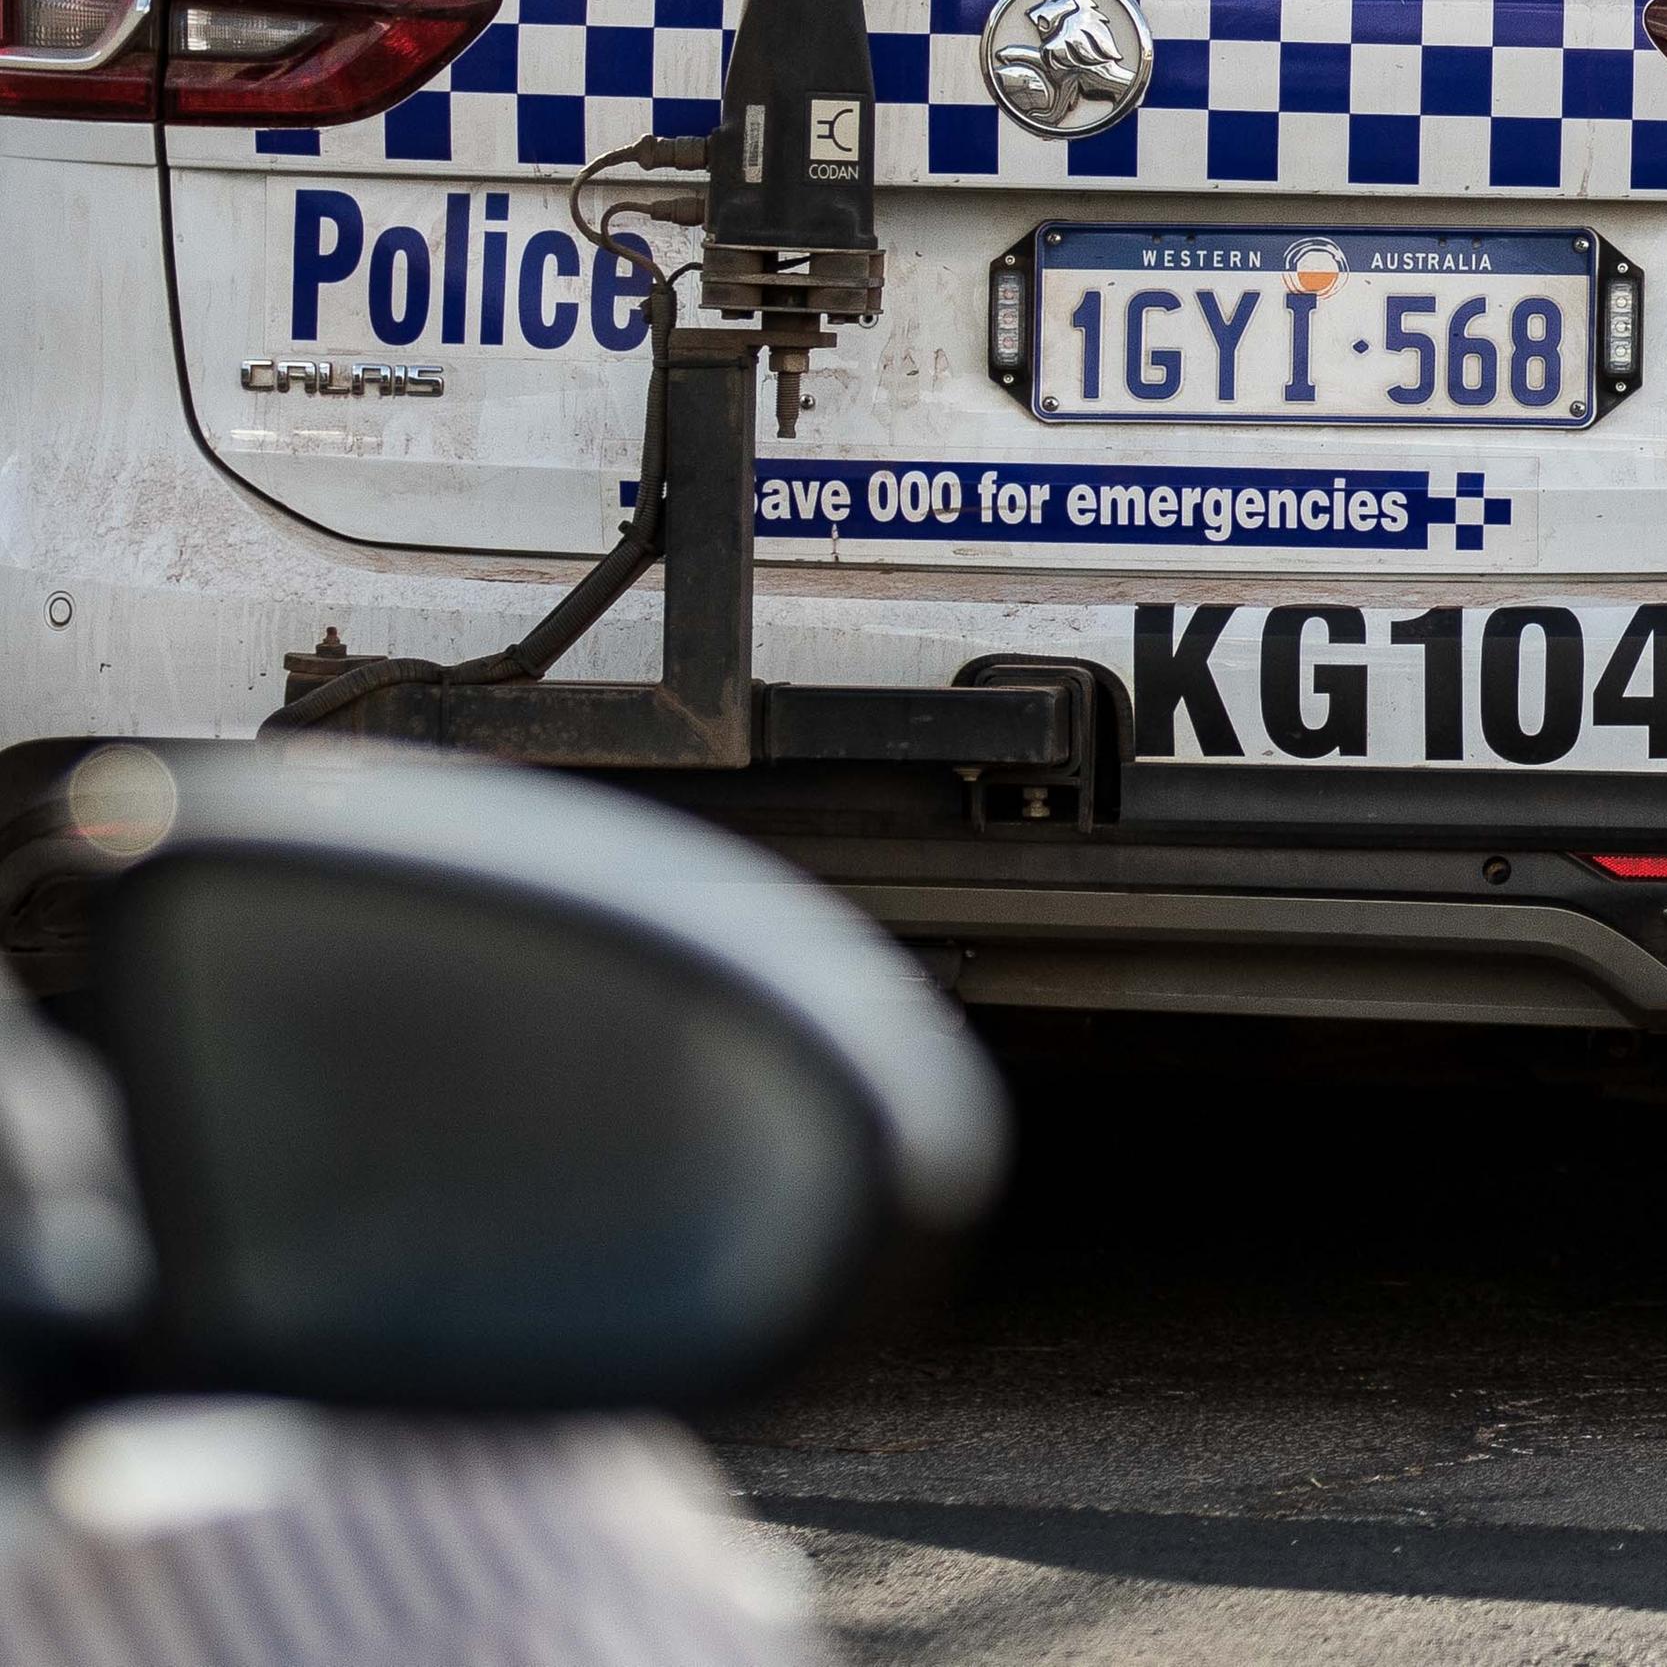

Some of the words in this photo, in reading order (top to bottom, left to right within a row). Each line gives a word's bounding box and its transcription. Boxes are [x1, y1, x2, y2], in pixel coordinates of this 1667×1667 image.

[809, 164, 859, 180] CODAN
[291, 188, 655, 351] Police
[1142, 248, 1262, 269] WESTERN
[1371, 252, 1493, 272] AUSTRALIA
[240, 358, 445, 397] CALAIS
[754, 477, 851, 522] ave
[867, 470, 962, 523] 000
[978, 471, 1050, 525] for
[1067, 477, 1409, 539] emergencies
